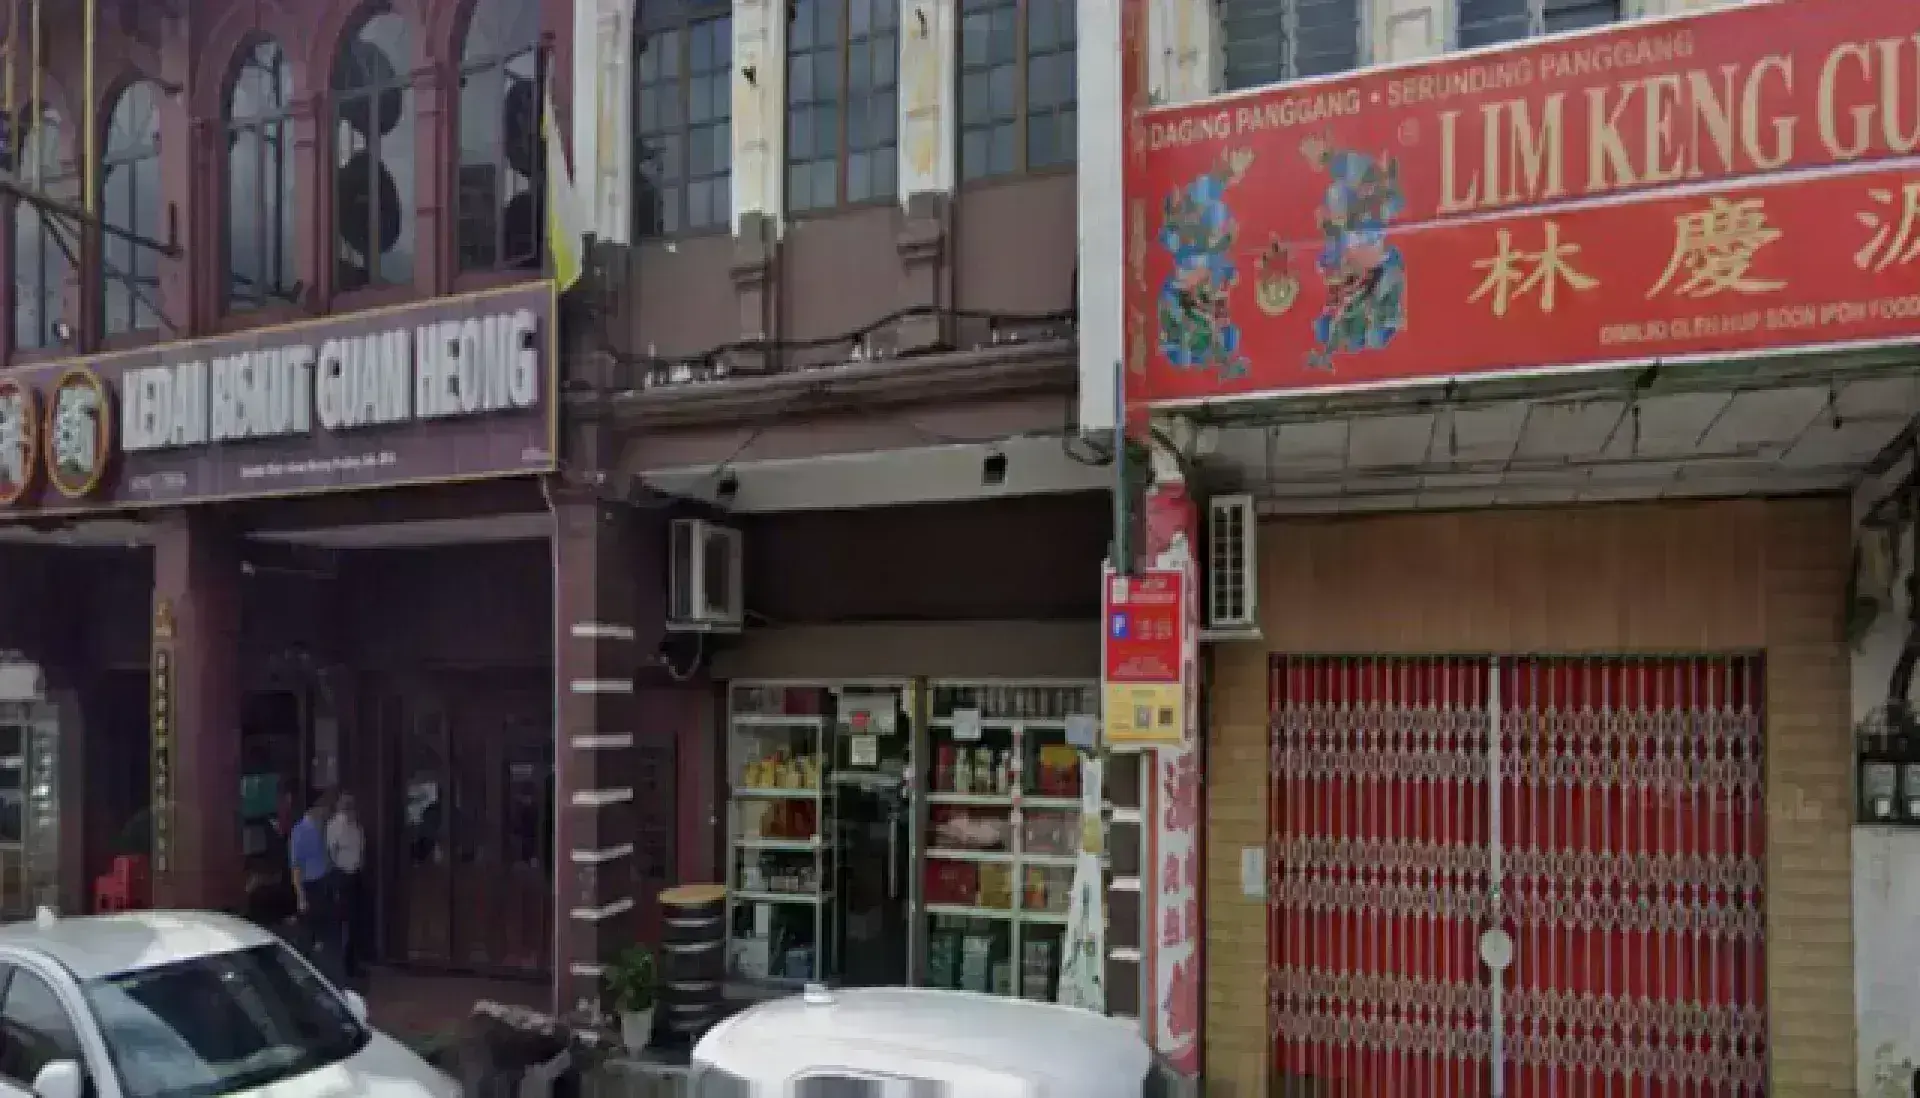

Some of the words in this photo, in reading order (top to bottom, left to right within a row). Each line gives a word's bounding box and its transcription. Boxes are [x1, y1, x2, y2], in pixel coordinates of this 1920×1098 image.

[1149, 110, 1230, 151] DAGING
[1235, 88, 1361, 136] PANGGANG
[1540, 29, 1695, 80] PANGGANG
[1437, 92, 1567, 214] LIM
[1583, 53, 1800, 193] KENG
[416, 307, 539, 418] HEONG
